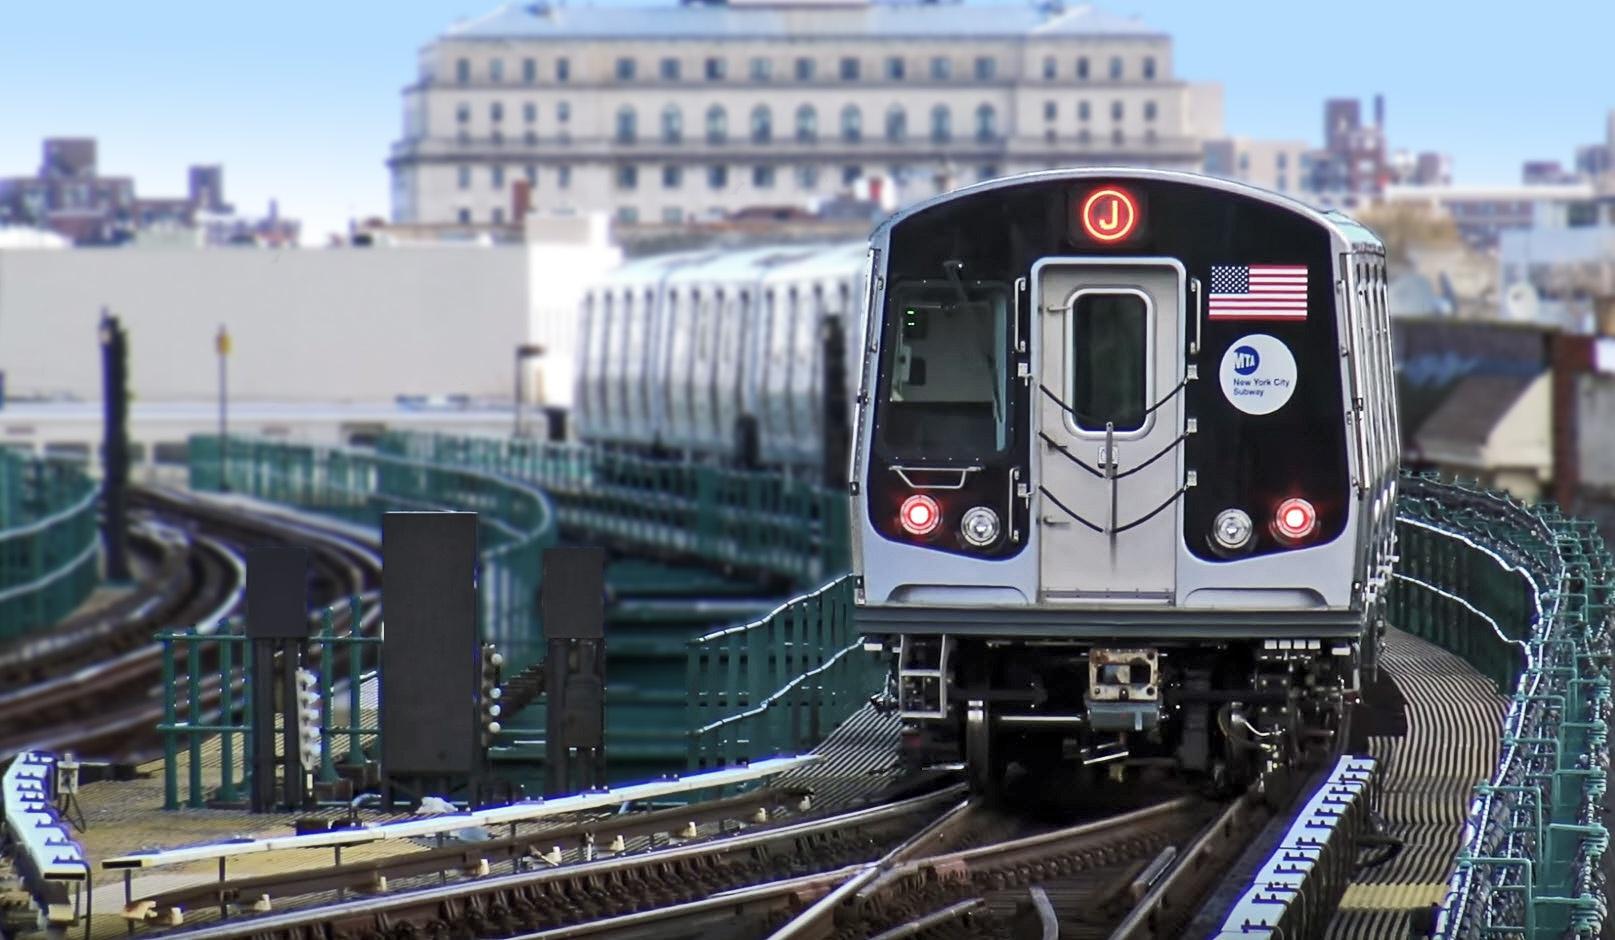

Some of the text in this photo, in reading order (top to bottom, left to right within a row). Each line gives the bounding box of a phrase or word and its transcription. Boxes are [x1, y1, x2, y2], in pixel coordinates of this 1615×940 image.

[1099, 200, 1118, 230] J
[1232, 351, 1256, 369] MTA
[1233, 378, 1290, 388] New York City
[1233, 388, 1264, 397] Subway
